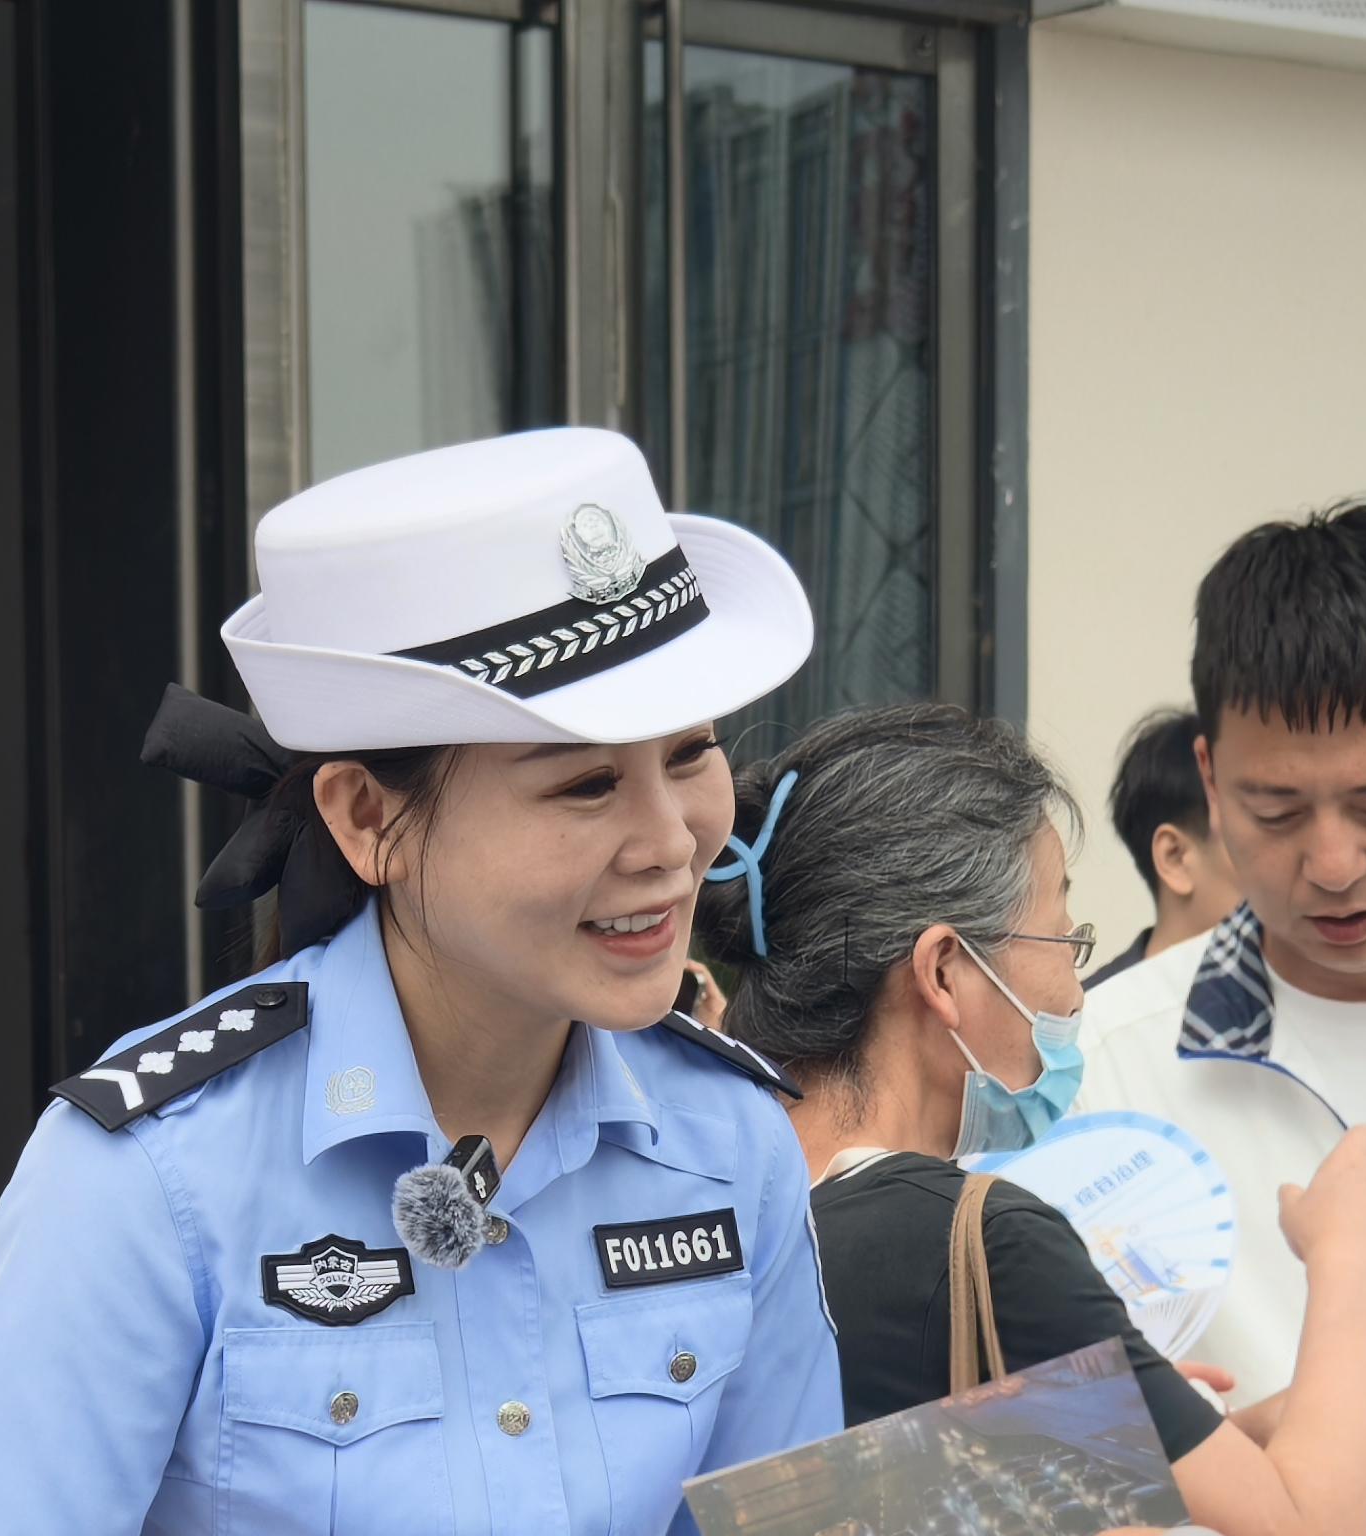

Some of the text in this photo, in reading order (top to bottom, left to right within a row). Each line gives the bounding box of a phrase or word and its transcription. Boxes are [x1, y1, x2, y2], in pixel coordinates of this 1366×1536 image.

[315, 1255, 354, 1273] 内蒙古
[606, 1223, 733, 1274] F011661
